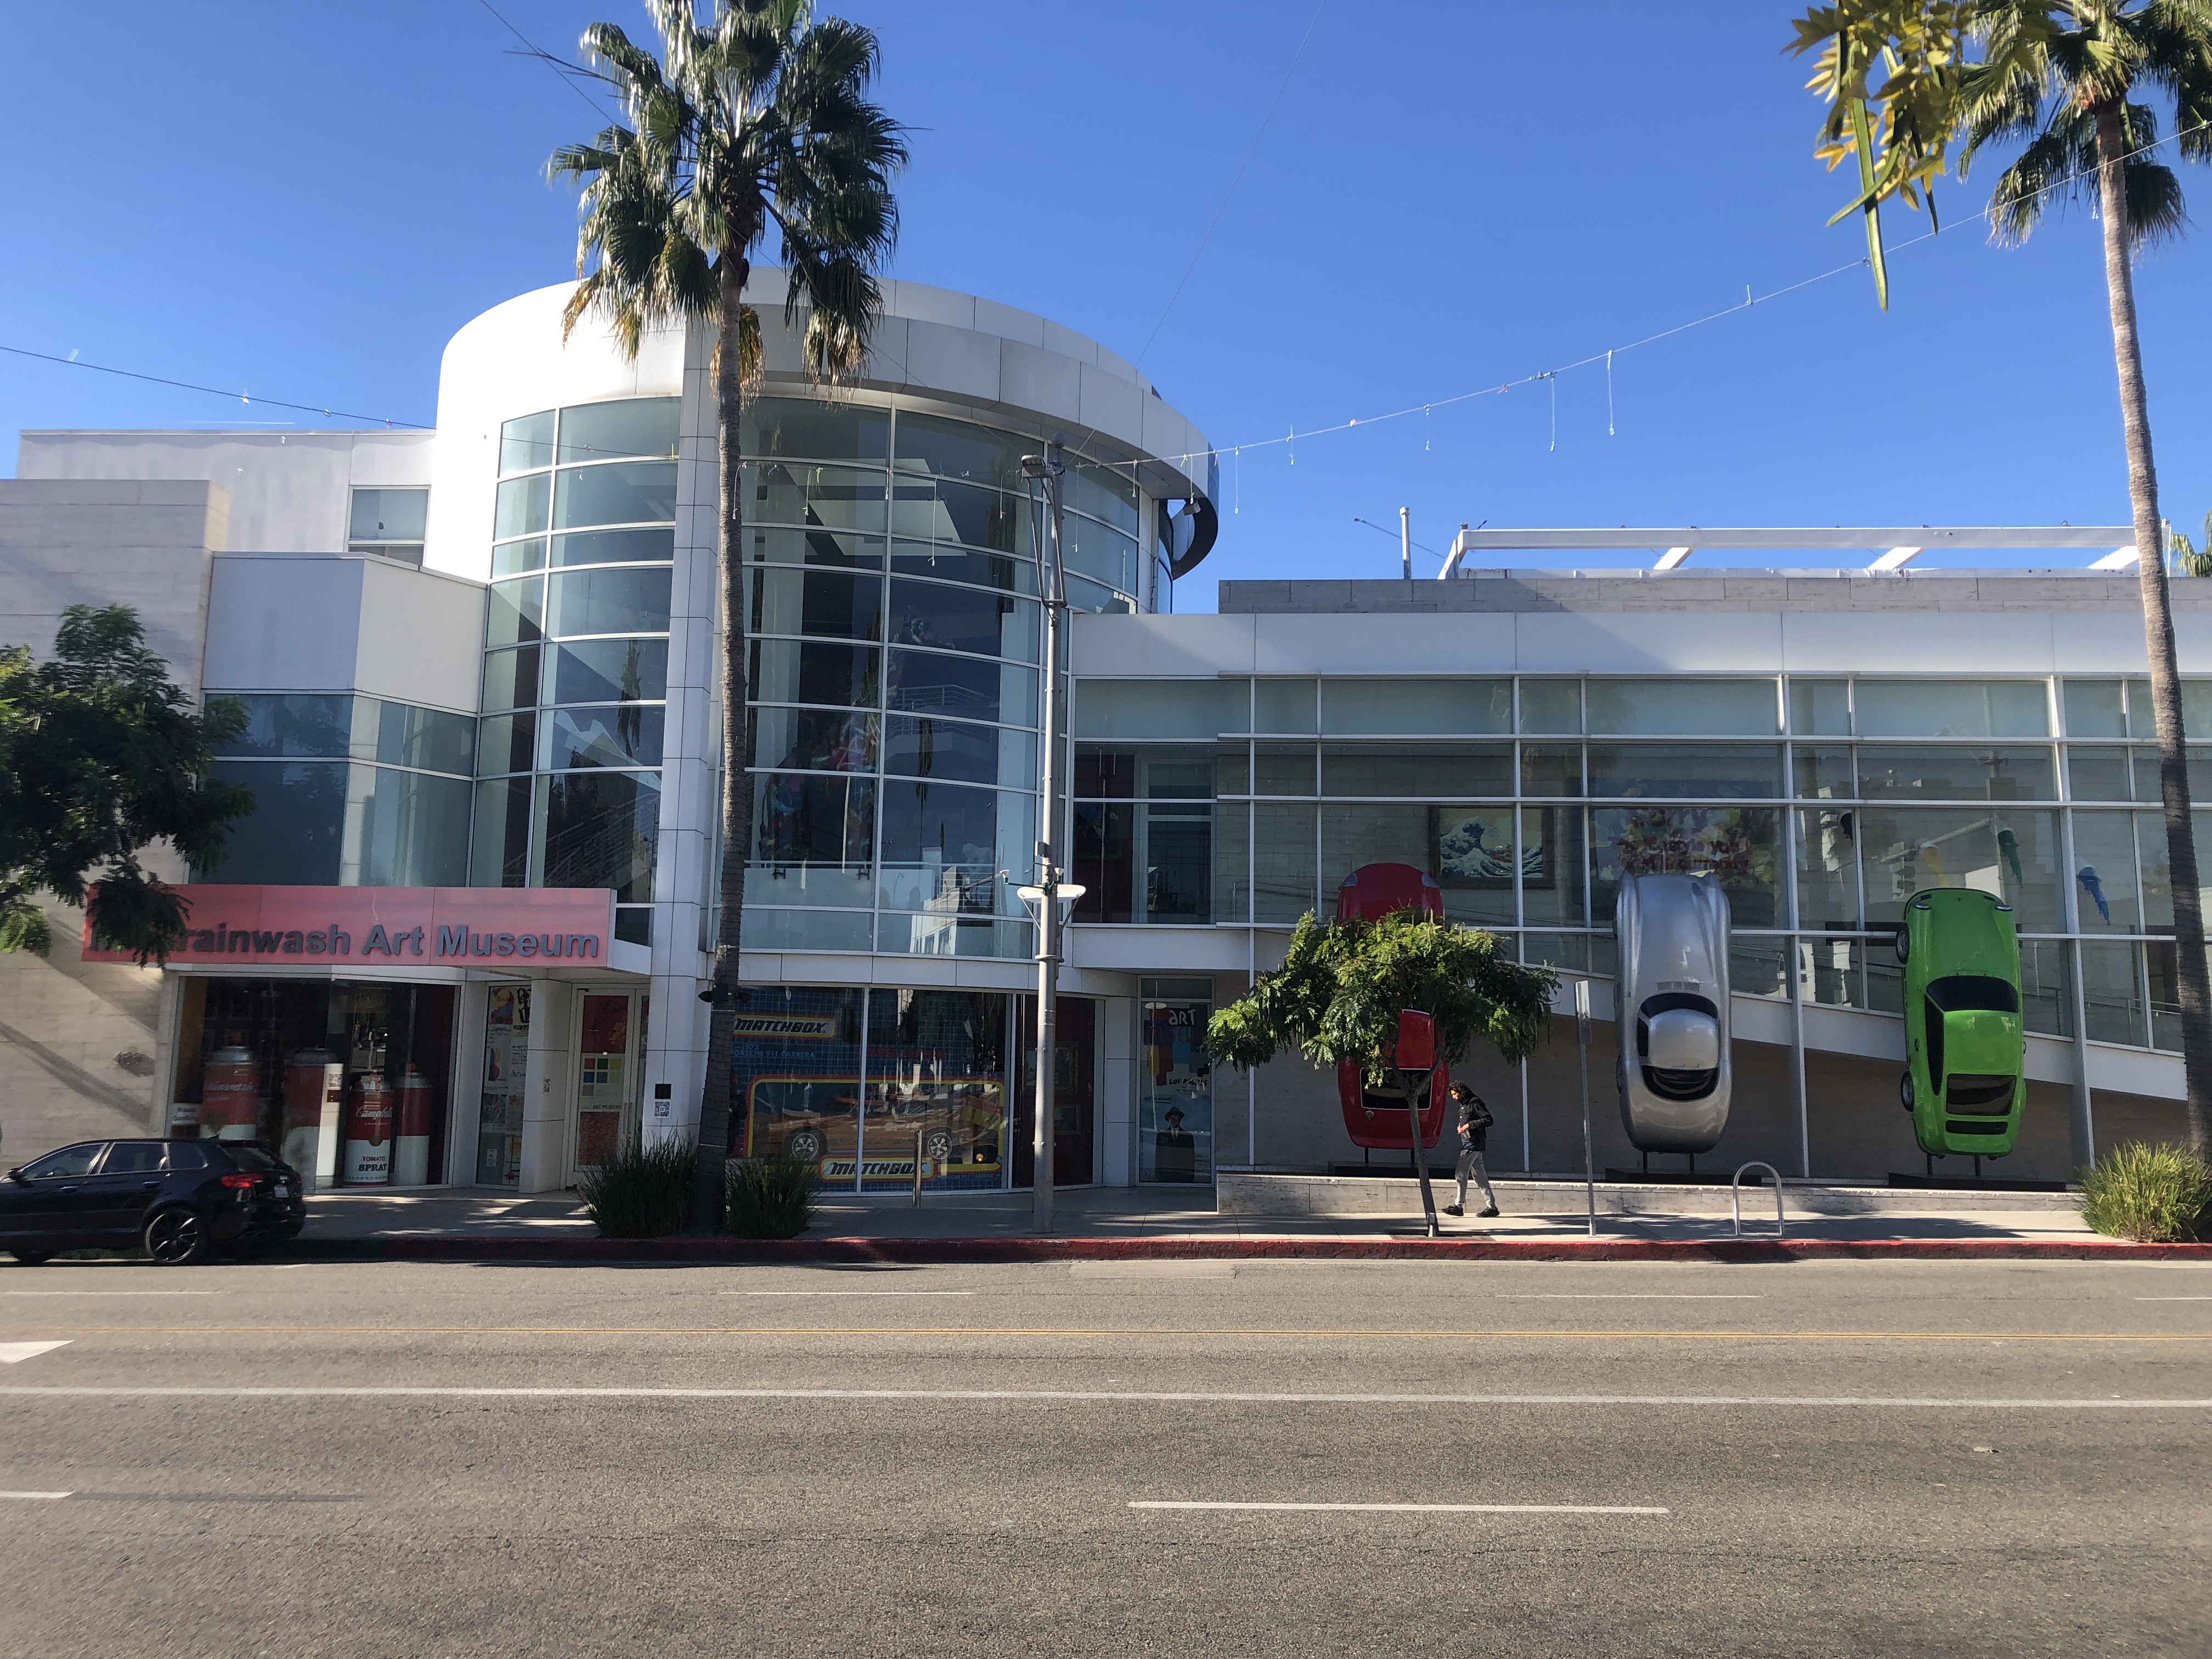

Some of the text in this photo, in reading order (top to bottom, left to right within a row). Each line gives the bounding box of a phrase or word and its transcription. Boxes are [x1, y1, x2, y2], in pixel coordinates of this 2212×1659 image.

[171, 922, 351, 955] rainwash
[362, 924, 424, 956] Art
[437, 924, 599, 957] Museum
[734, 1018, 826, 1034] MATCHBOX
[358, 1163, 387, 1171] SPRAY
